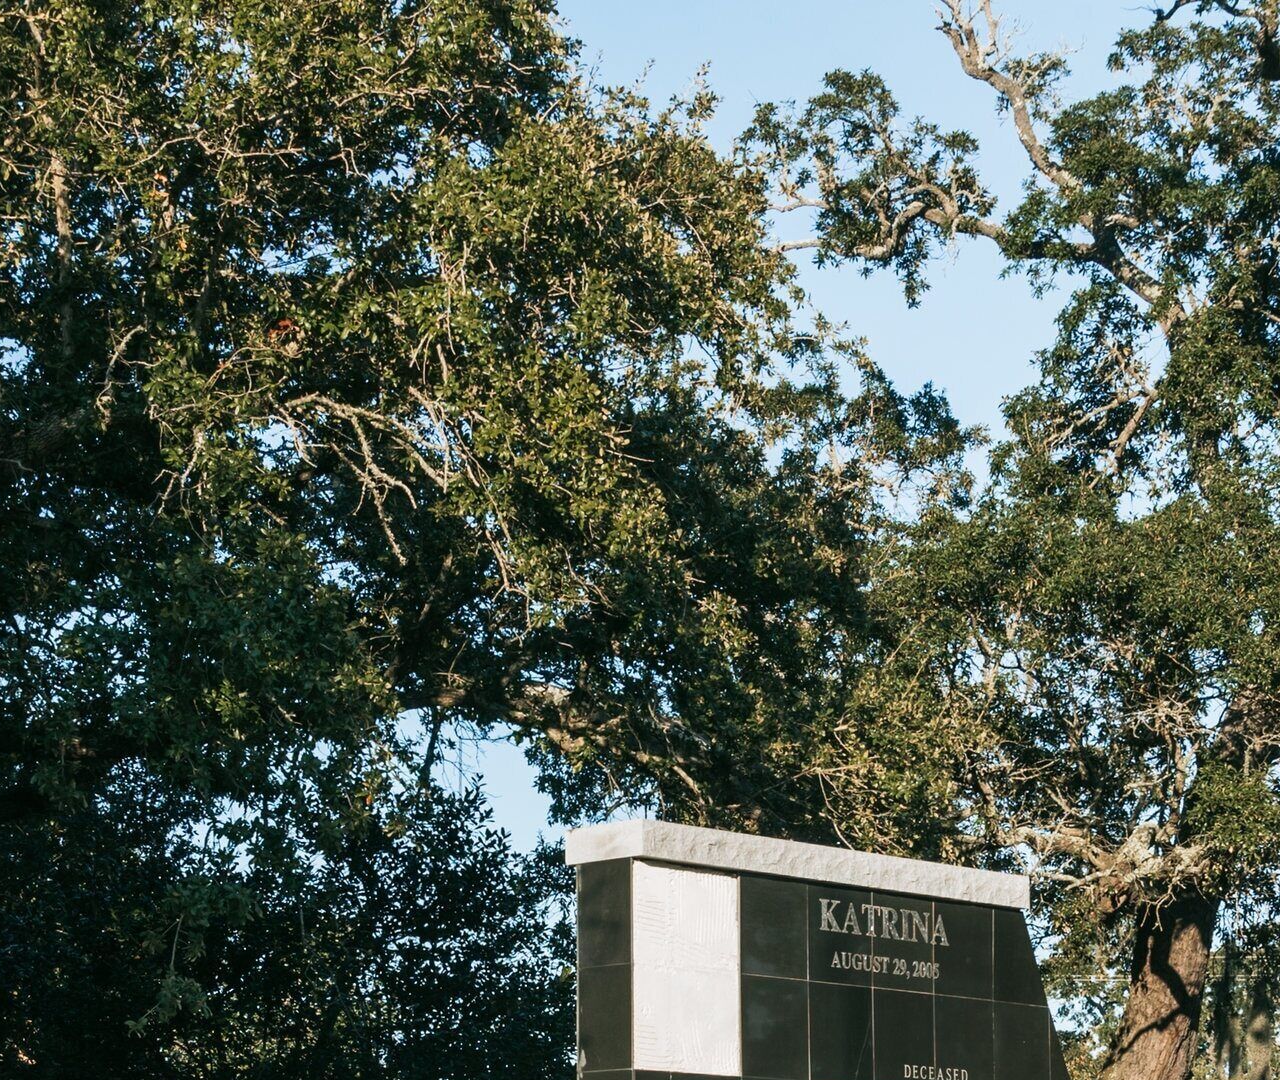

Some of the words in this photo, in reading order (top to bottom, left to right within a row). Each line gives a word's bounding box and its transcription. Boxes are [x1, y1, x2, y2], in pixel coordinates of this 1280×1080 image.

[819, 898, 949, 946] KATRINA
[831, 951, 890, 974] AUGUST
[893, 958, 910, 980] 29,
[912, 961, 940, 979] 2005
